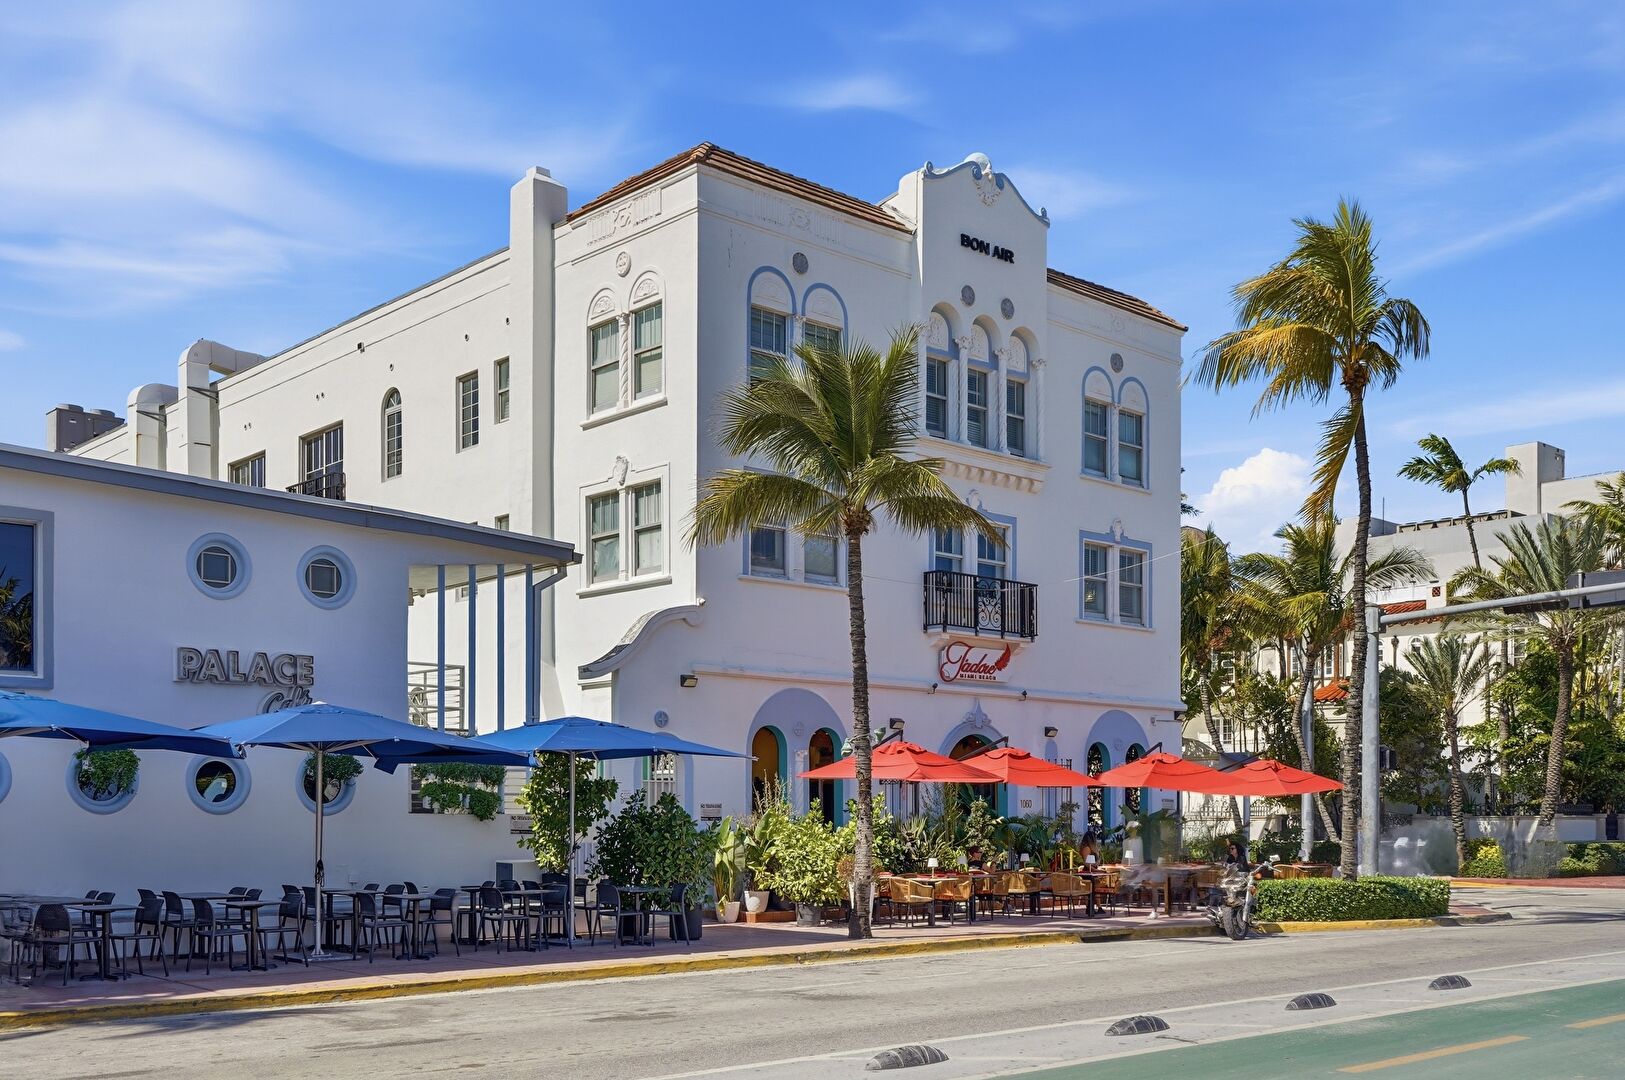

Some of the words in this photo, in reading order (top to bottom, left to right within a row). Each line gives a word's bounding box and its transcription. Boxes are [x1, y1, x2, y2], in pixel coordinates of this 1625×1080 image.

[960, 233, 990, 256] BON
[992, 245, 1015, 264] AIR
[175, 646, 314, 687] PALACE
